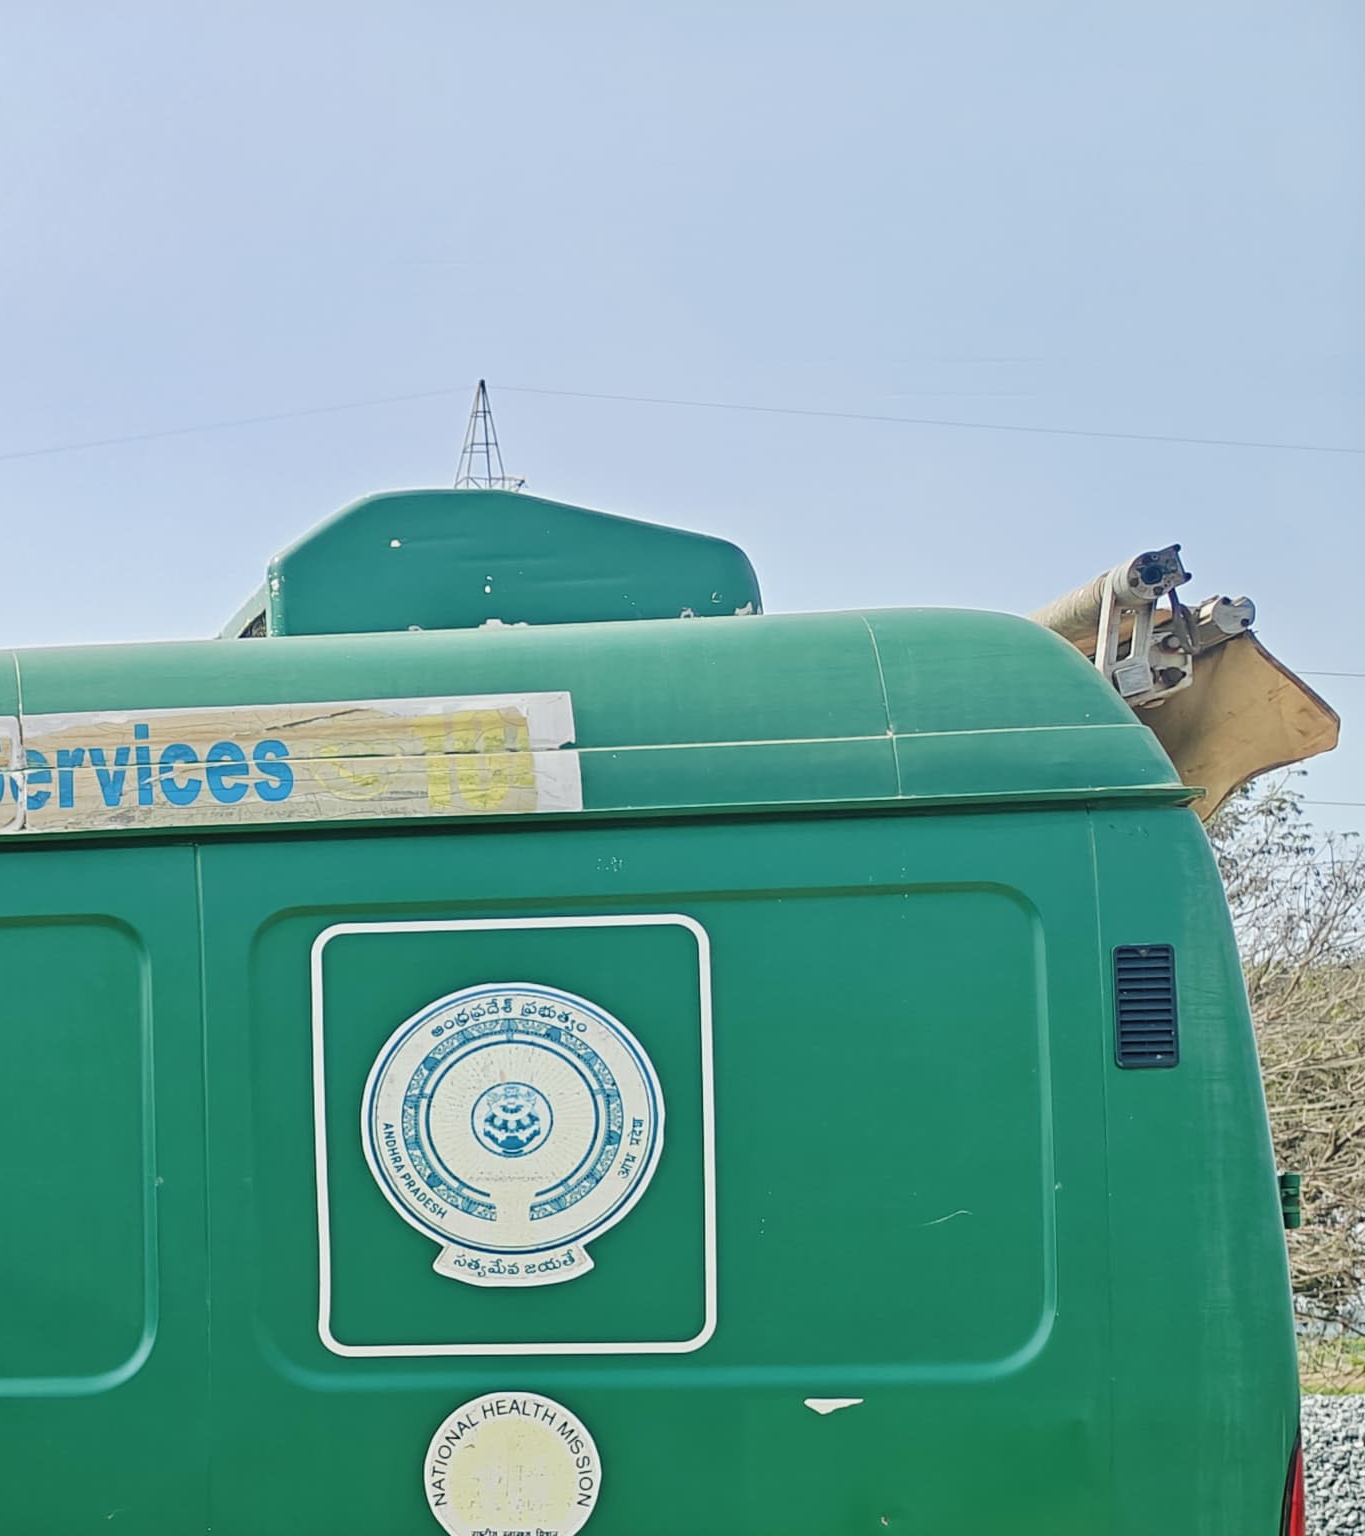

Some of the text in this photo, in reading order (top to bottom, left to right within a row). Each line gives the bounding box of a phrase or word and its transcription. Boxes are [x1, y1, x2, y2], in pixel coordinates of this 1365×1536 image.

[383, 1123, 448, 1219] ANDHRA PRADESH
[431, 1399, 594, 1508] NATIONAL HEALTH MISSION
